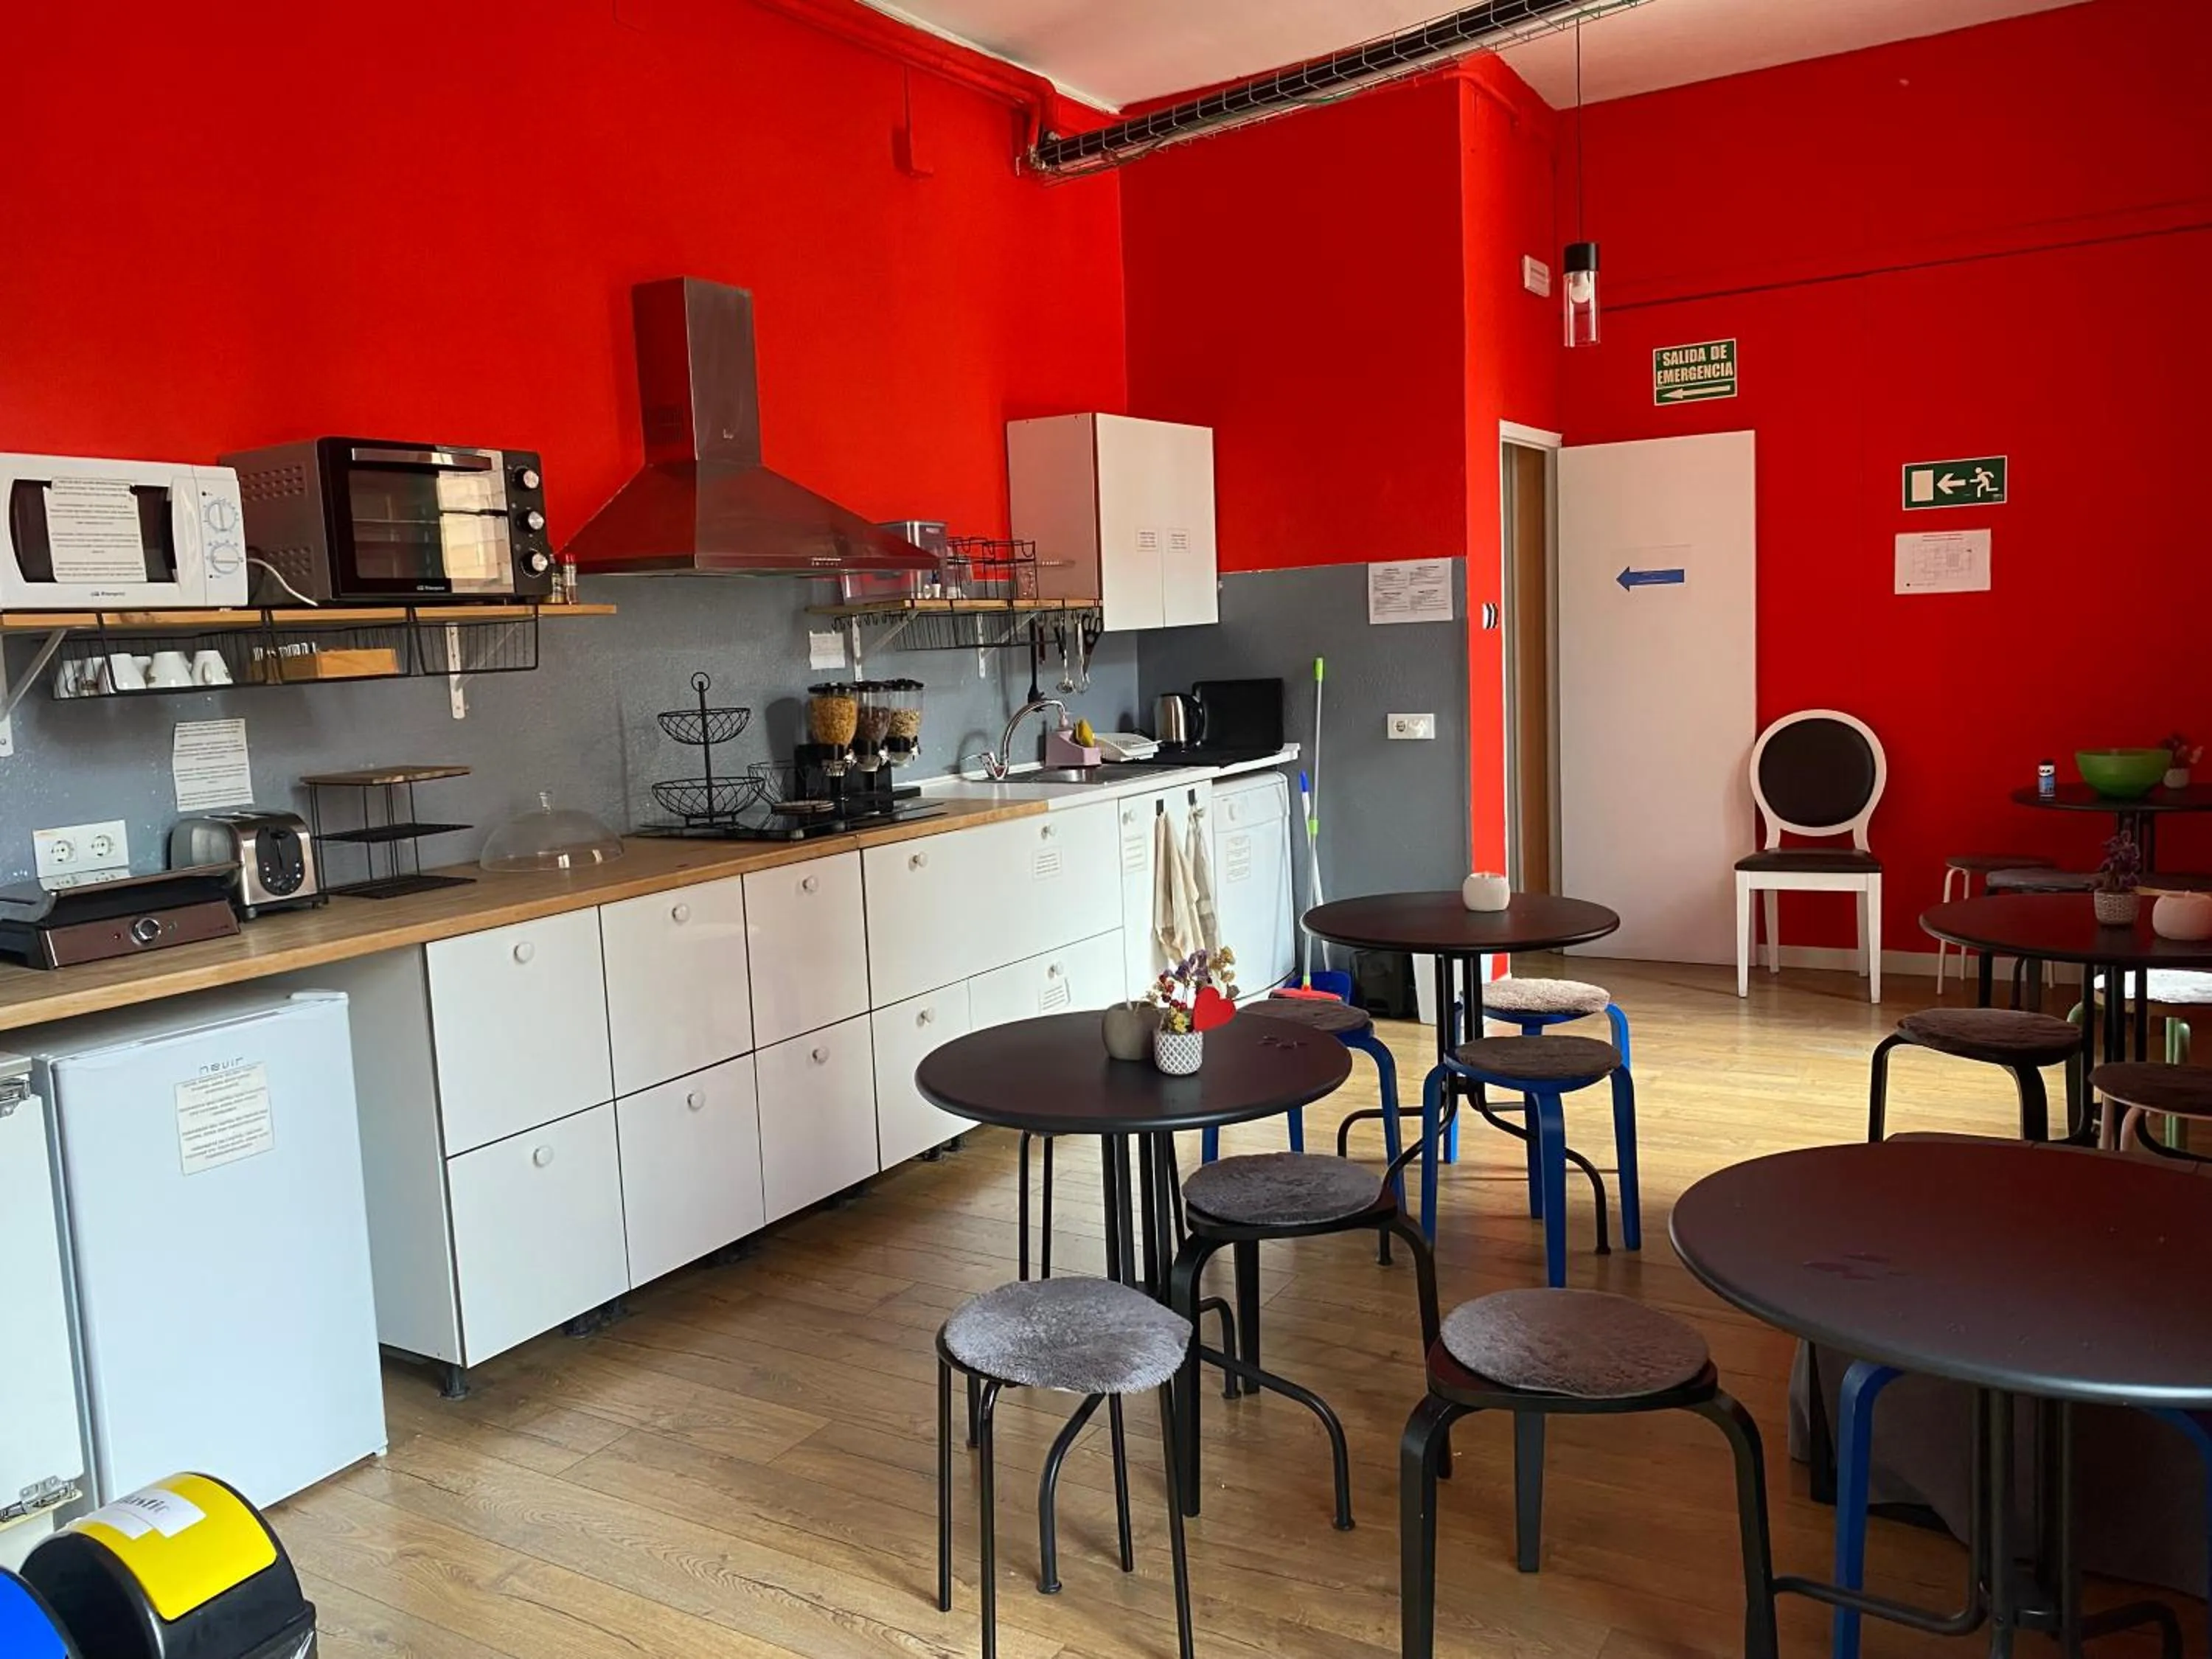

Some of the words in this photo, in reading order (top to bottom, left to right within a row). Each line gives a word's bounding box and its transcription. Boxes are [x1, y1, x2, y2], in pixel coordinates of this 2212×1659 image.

[1662, 347, 1706, 366] SALIDA
[1711, 344, 1728, 361] DE
[1657, 361, 1733, 385] EMERGENCIA
